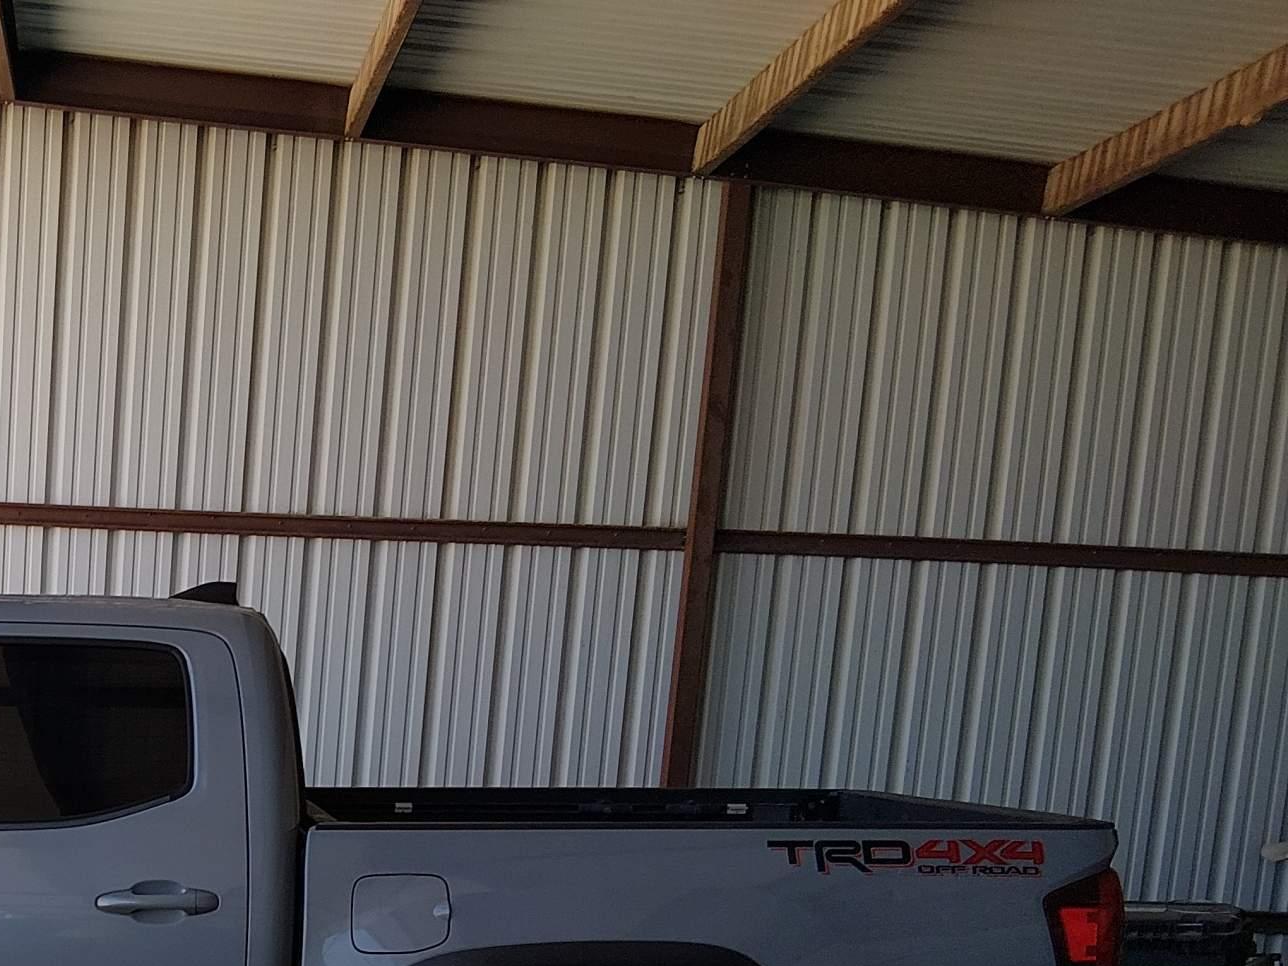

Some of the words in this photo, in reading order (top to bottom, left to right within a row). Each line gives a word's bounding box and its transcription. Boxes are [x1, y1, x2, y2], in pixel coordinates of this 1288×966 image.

[767, 839, 913, 874] TRD
[915, 839, 1045, 865] 4X4
[917, 865, 963, 876] OFF
[970, 865, 1043, 877] ROAD
